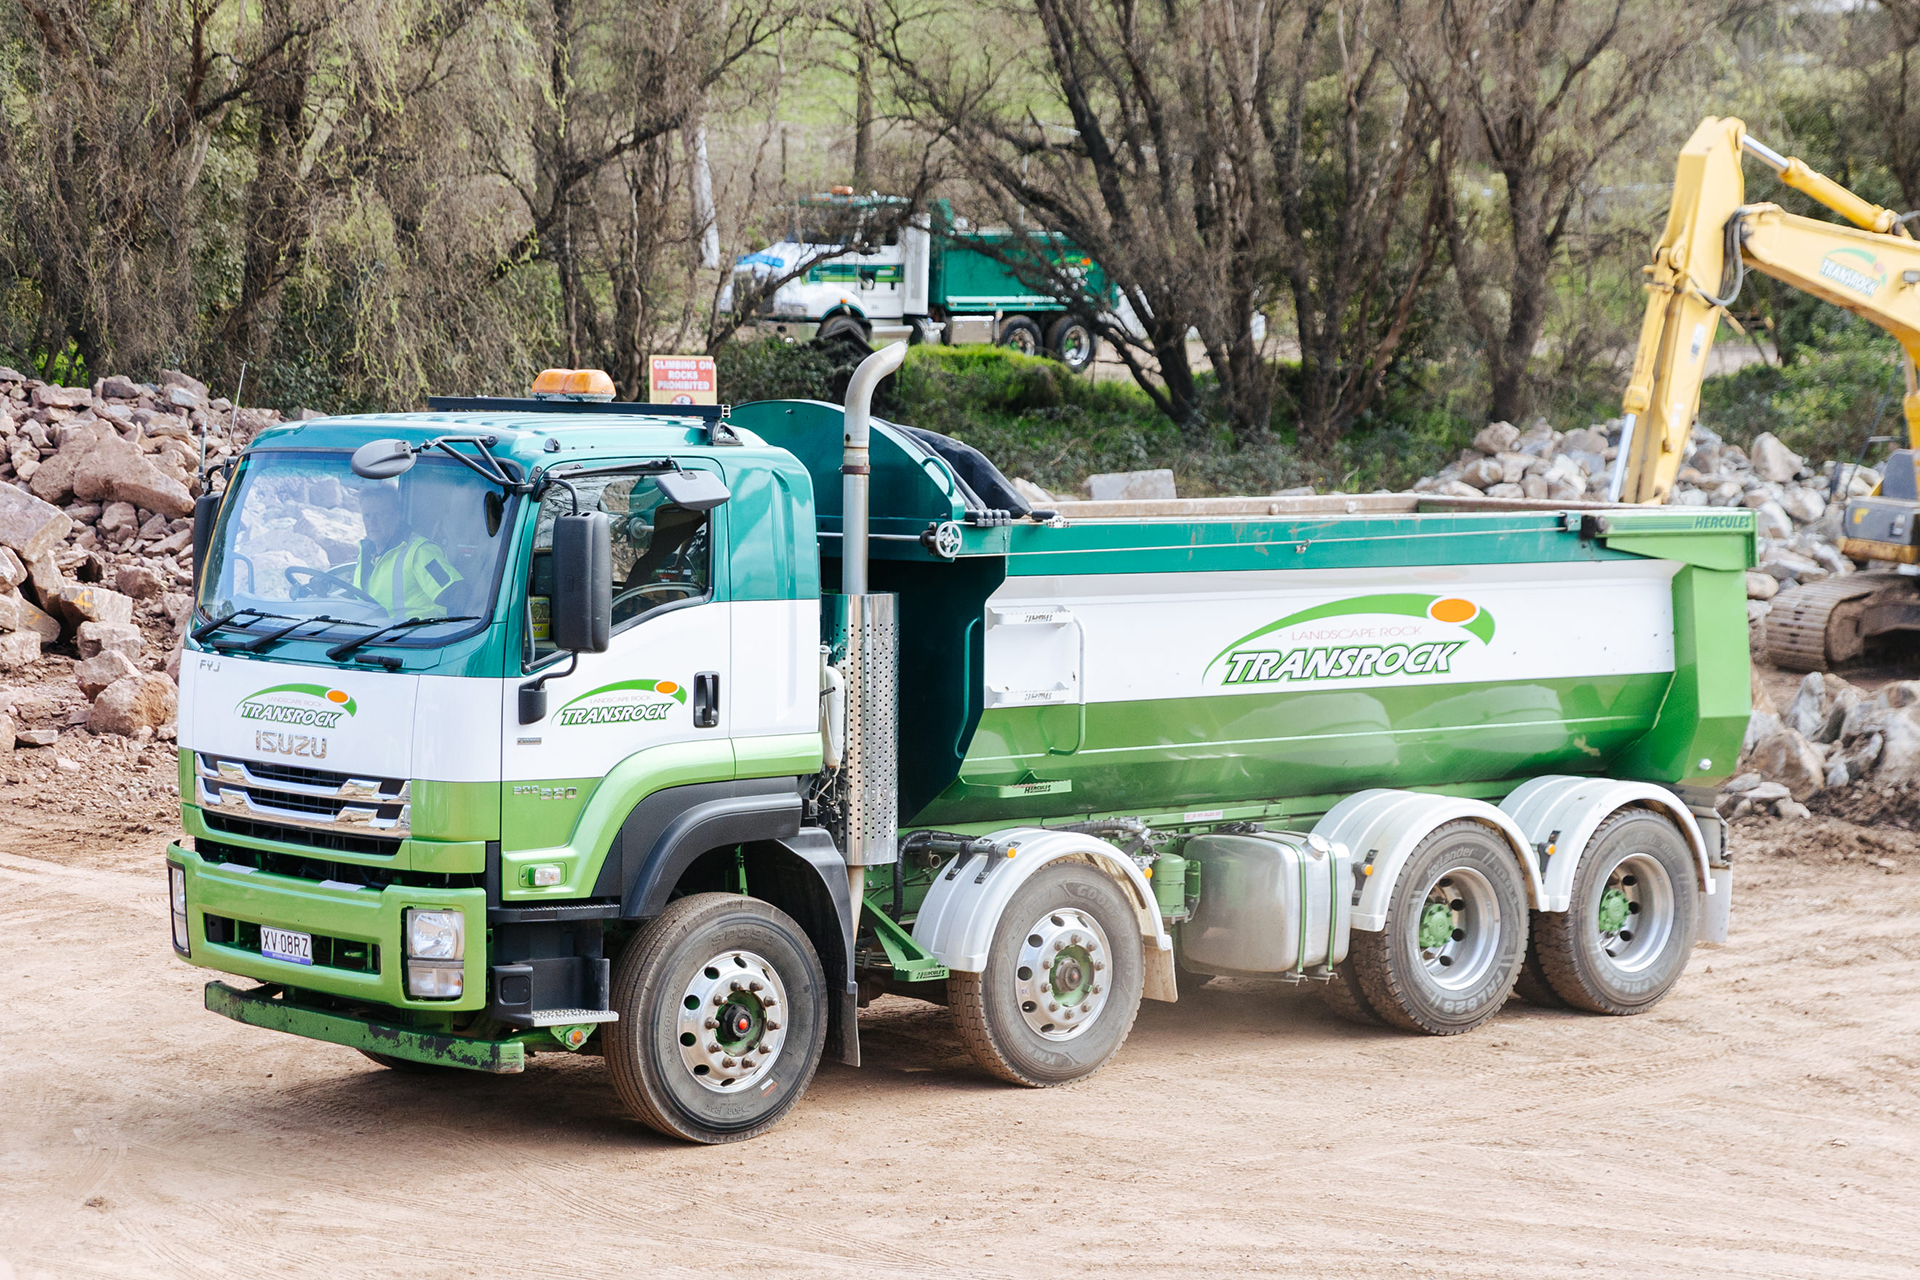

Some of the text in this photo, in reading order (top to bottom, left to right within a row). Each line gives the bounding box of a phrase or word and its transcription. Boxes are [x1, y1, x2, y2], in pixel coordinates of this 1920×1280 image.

[1819, 257, 1880, 297] TRANSROCK
[653, 360, 713, 370] CLIMBING ON
[667, 370, 699, 380] ROCKS
[656, 380, 710, 390] PROHIBITED
[1694, 516, 1751, 529] HERCULES
[1291, 625, 1422, 641] LANDSCAPE ROCK
[199, 659, 221, 673] FYJ
[1221, 640, 1469, 685] TRANSROCK
[267, 696, 303, 706] LANDSCAPE
[589, 696, 629, 705] LANDSCAPE
[241, 702, 344, 728] TRANSROCK
[560, 703, 674, 726] TRANSROCK
[255, 729, 327, 759] ISUZU
